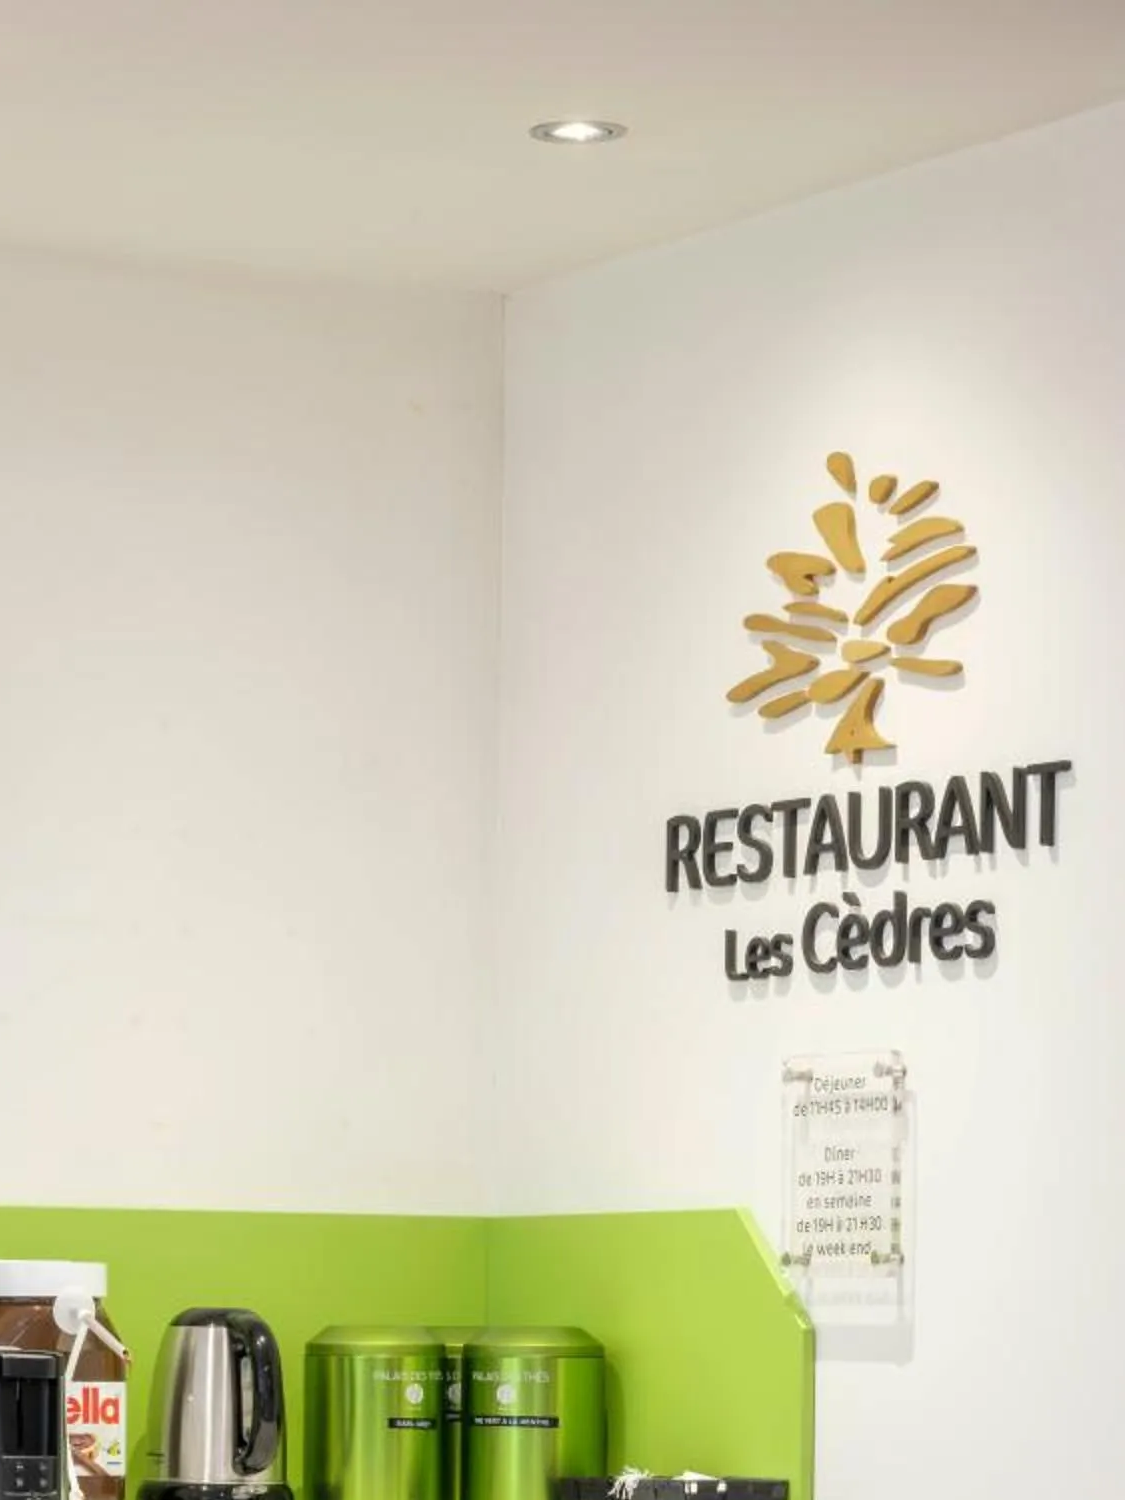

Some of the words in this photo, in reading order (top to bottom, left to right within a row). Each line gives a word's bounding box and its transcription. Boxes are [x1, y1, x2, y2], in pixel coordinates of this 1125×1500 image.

[666, 760, 1072, 892] RESTAURANT
[725, 929, 794, 981] Les
[802, 891, 996, 973] Cèdres
[814, 1074, 866, 1094] Déjeuner
[794, 1102, 808, 1117] de
[798, 1172, 811, 1188] de
[814, 1170, 836, 1187] 19H
[807, 1196, 821, 1210] en
[824, 1192, 872, 1210] semaine
[797, 1218, 811, 1233] de
[813, 1216, 834, 1233] 19H
[817, 1241, 846, 1257] week
